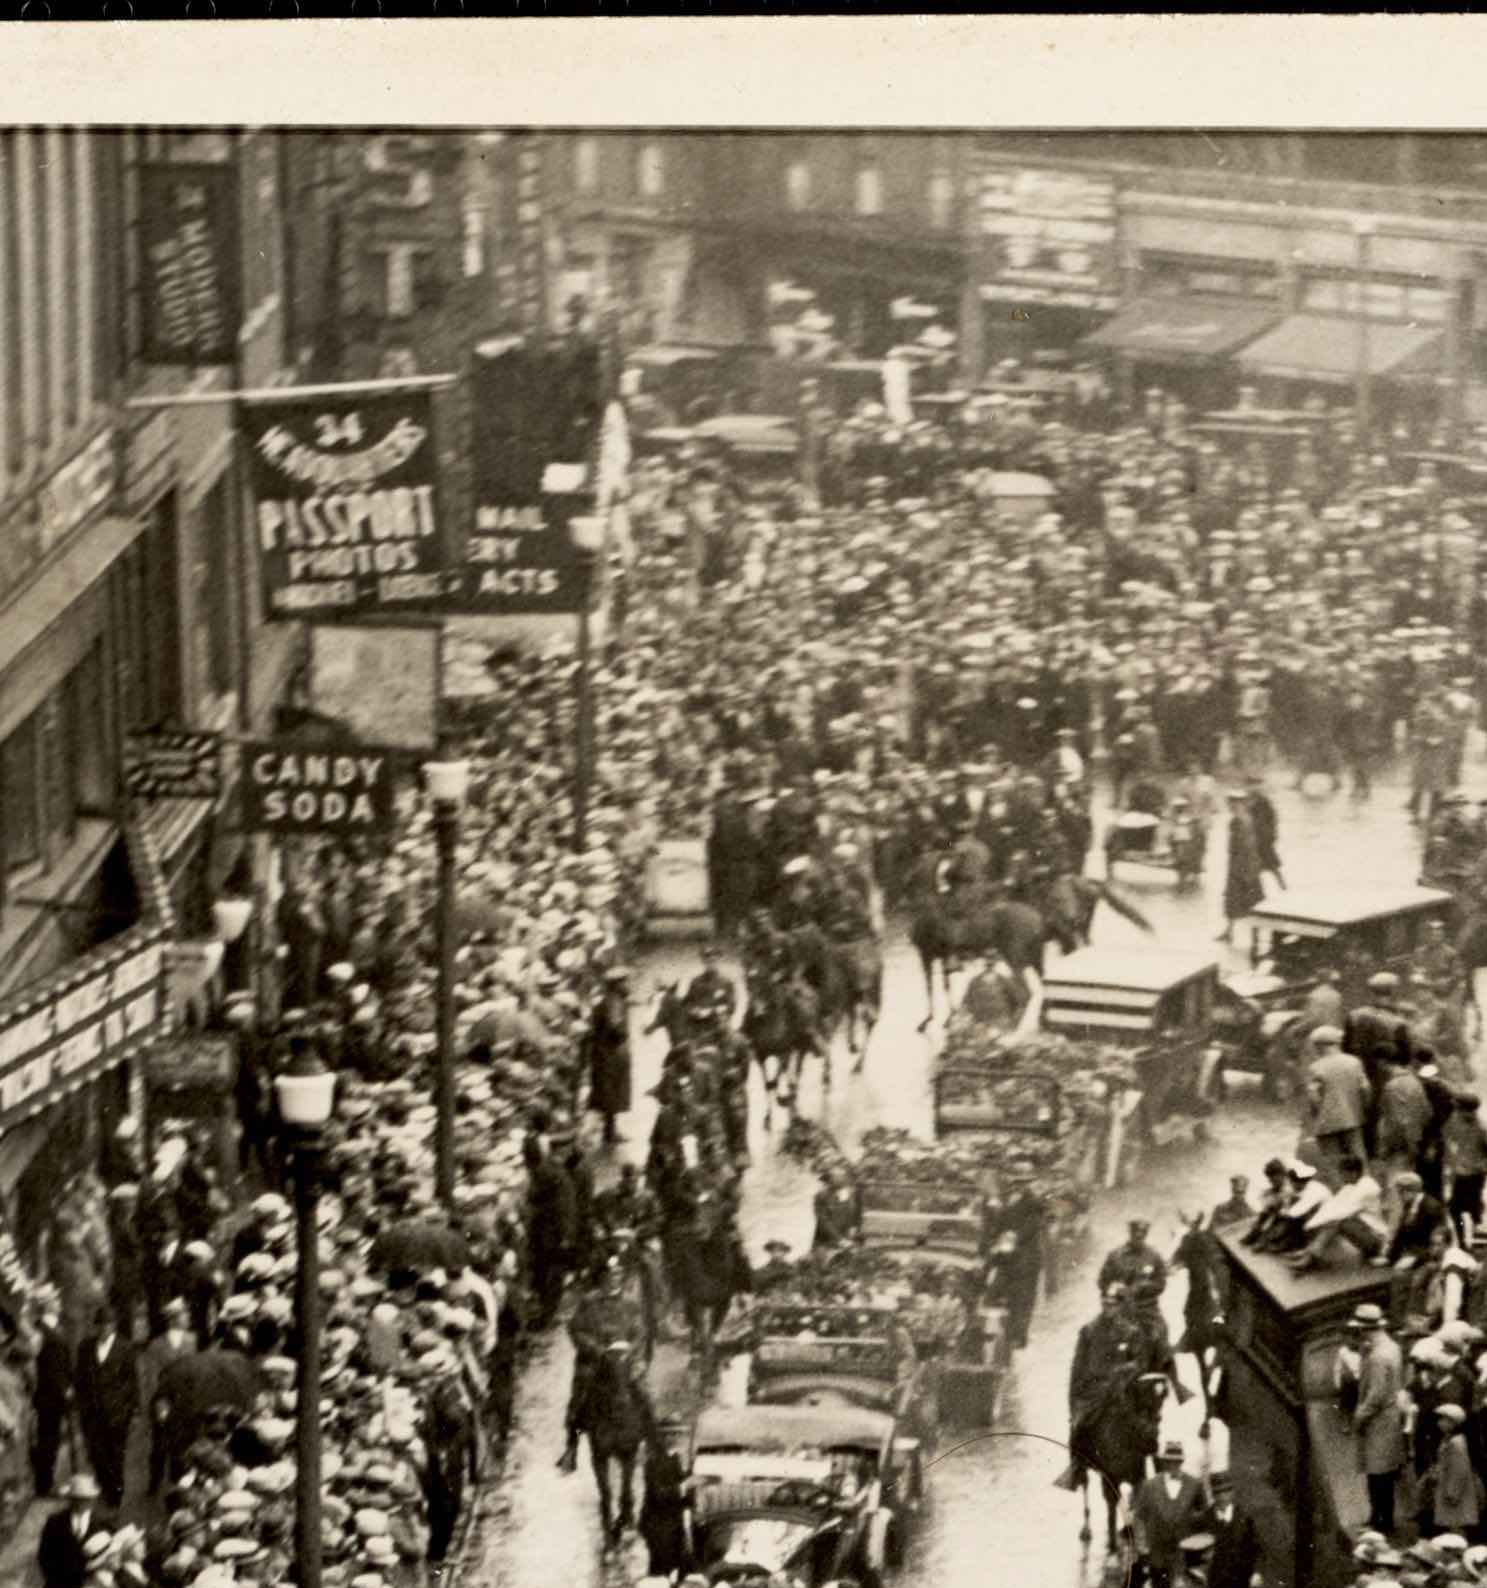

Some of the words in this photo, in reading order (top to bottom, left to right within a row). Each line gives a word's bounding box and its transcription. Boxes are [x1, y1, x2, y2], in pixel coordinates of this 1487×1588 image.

[259, 485, 435, 550] PASSPORT
[289, 540, 419, 579] PHOTOS
[252, 753, 384, 787] CANDY
[262, 789, 374, 822] SODA
